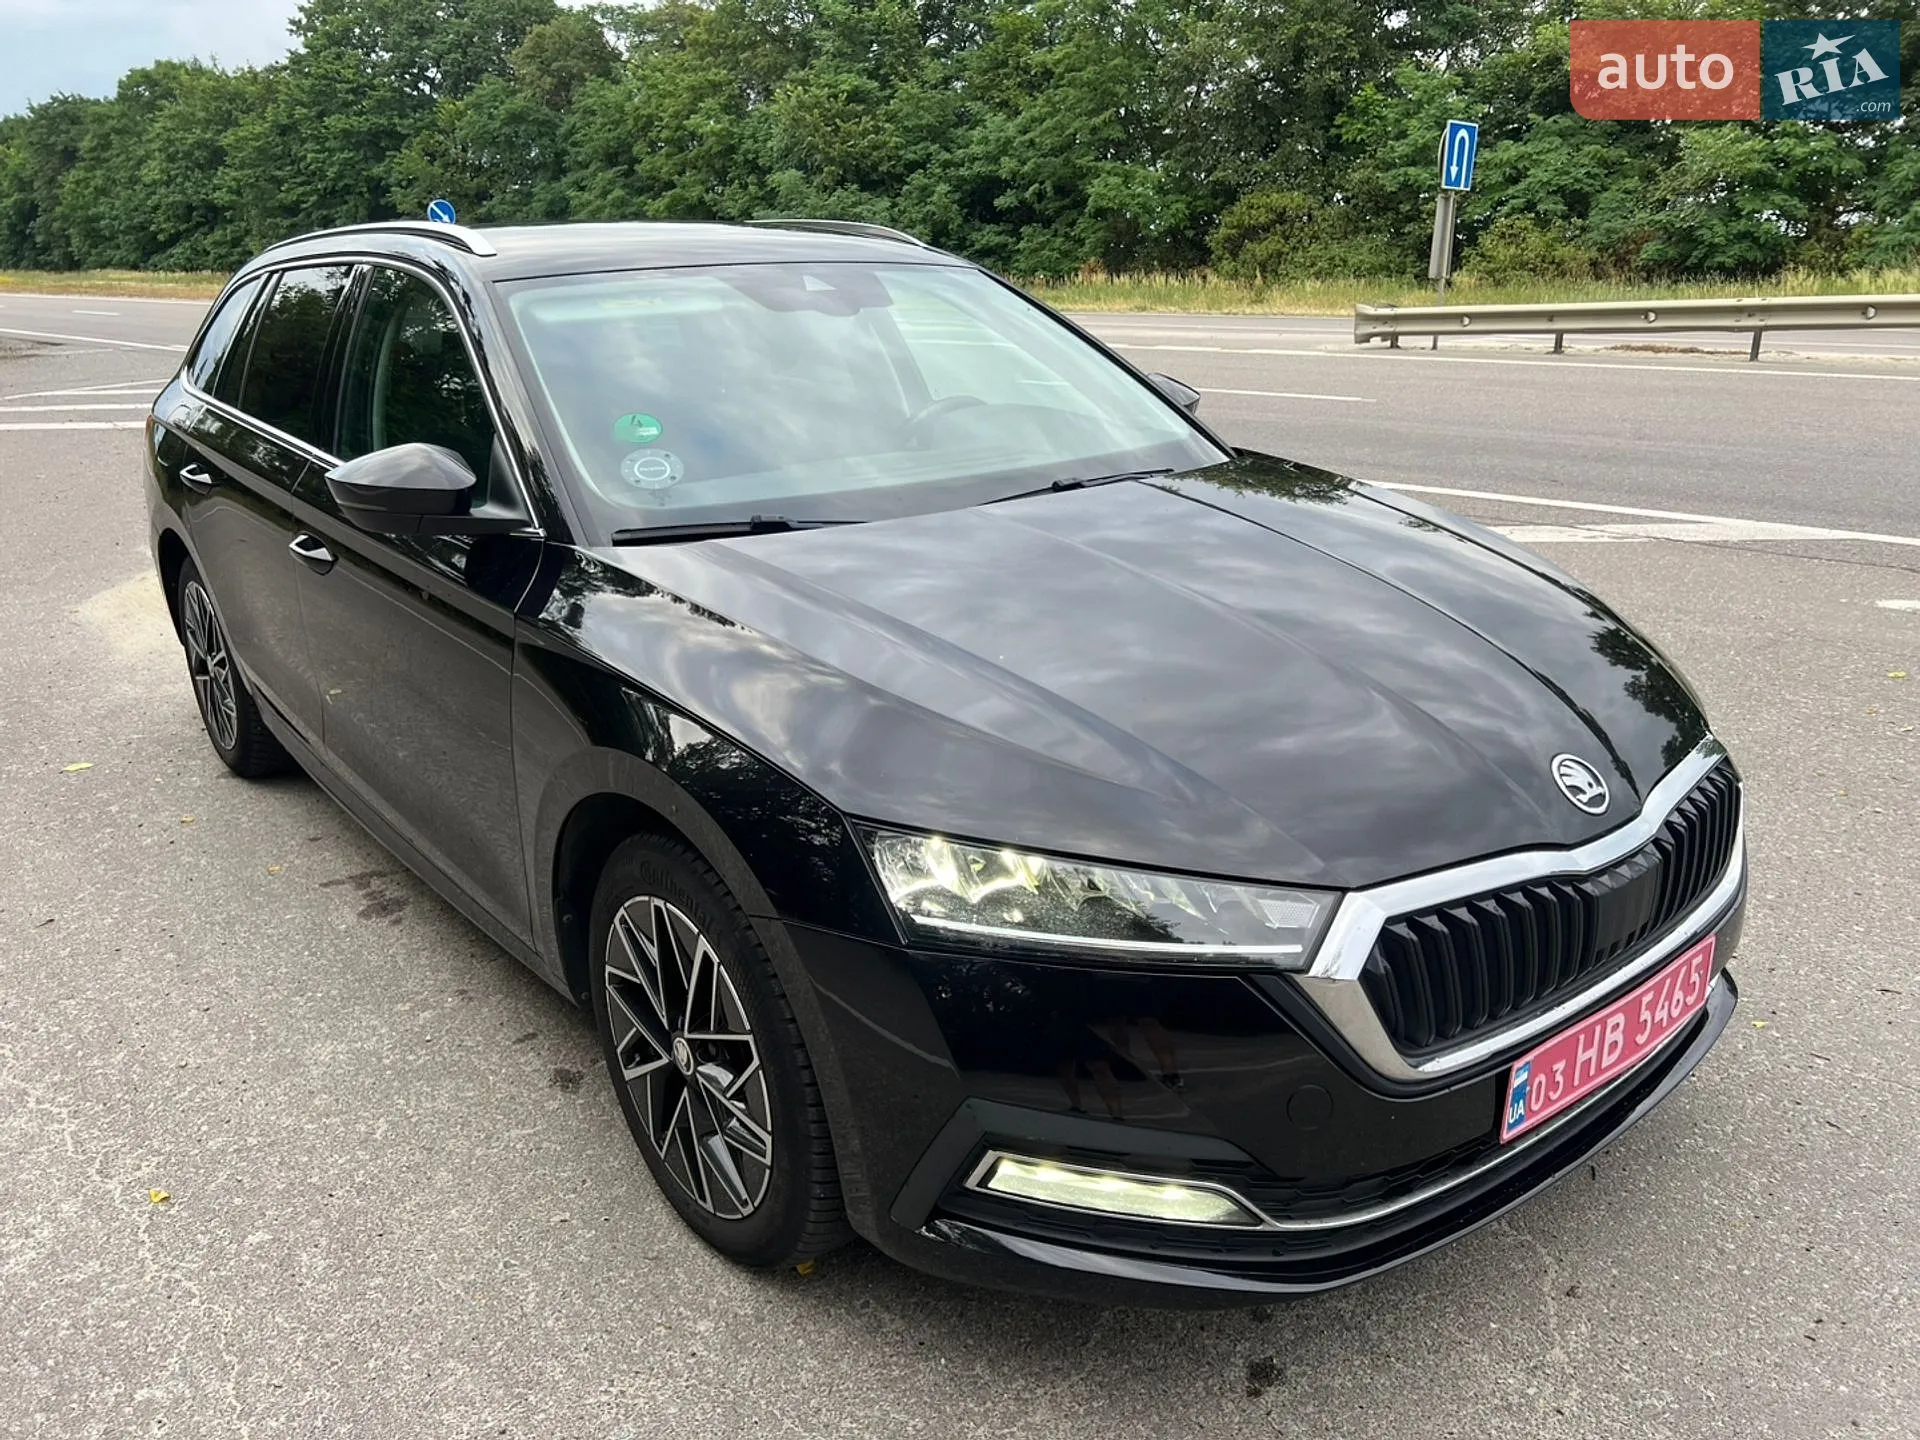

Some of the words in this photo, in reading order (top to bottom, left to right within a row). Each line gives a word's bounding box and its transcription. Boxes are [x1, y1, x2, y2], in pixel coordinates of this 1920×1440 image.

[1529, 1059, 1567, 1112] 03
[1573, 1012, 1626, 1087] HB
[1634, 953, 1704, 1046] 5465
[1508, 1099, 1525, 1124] UA
